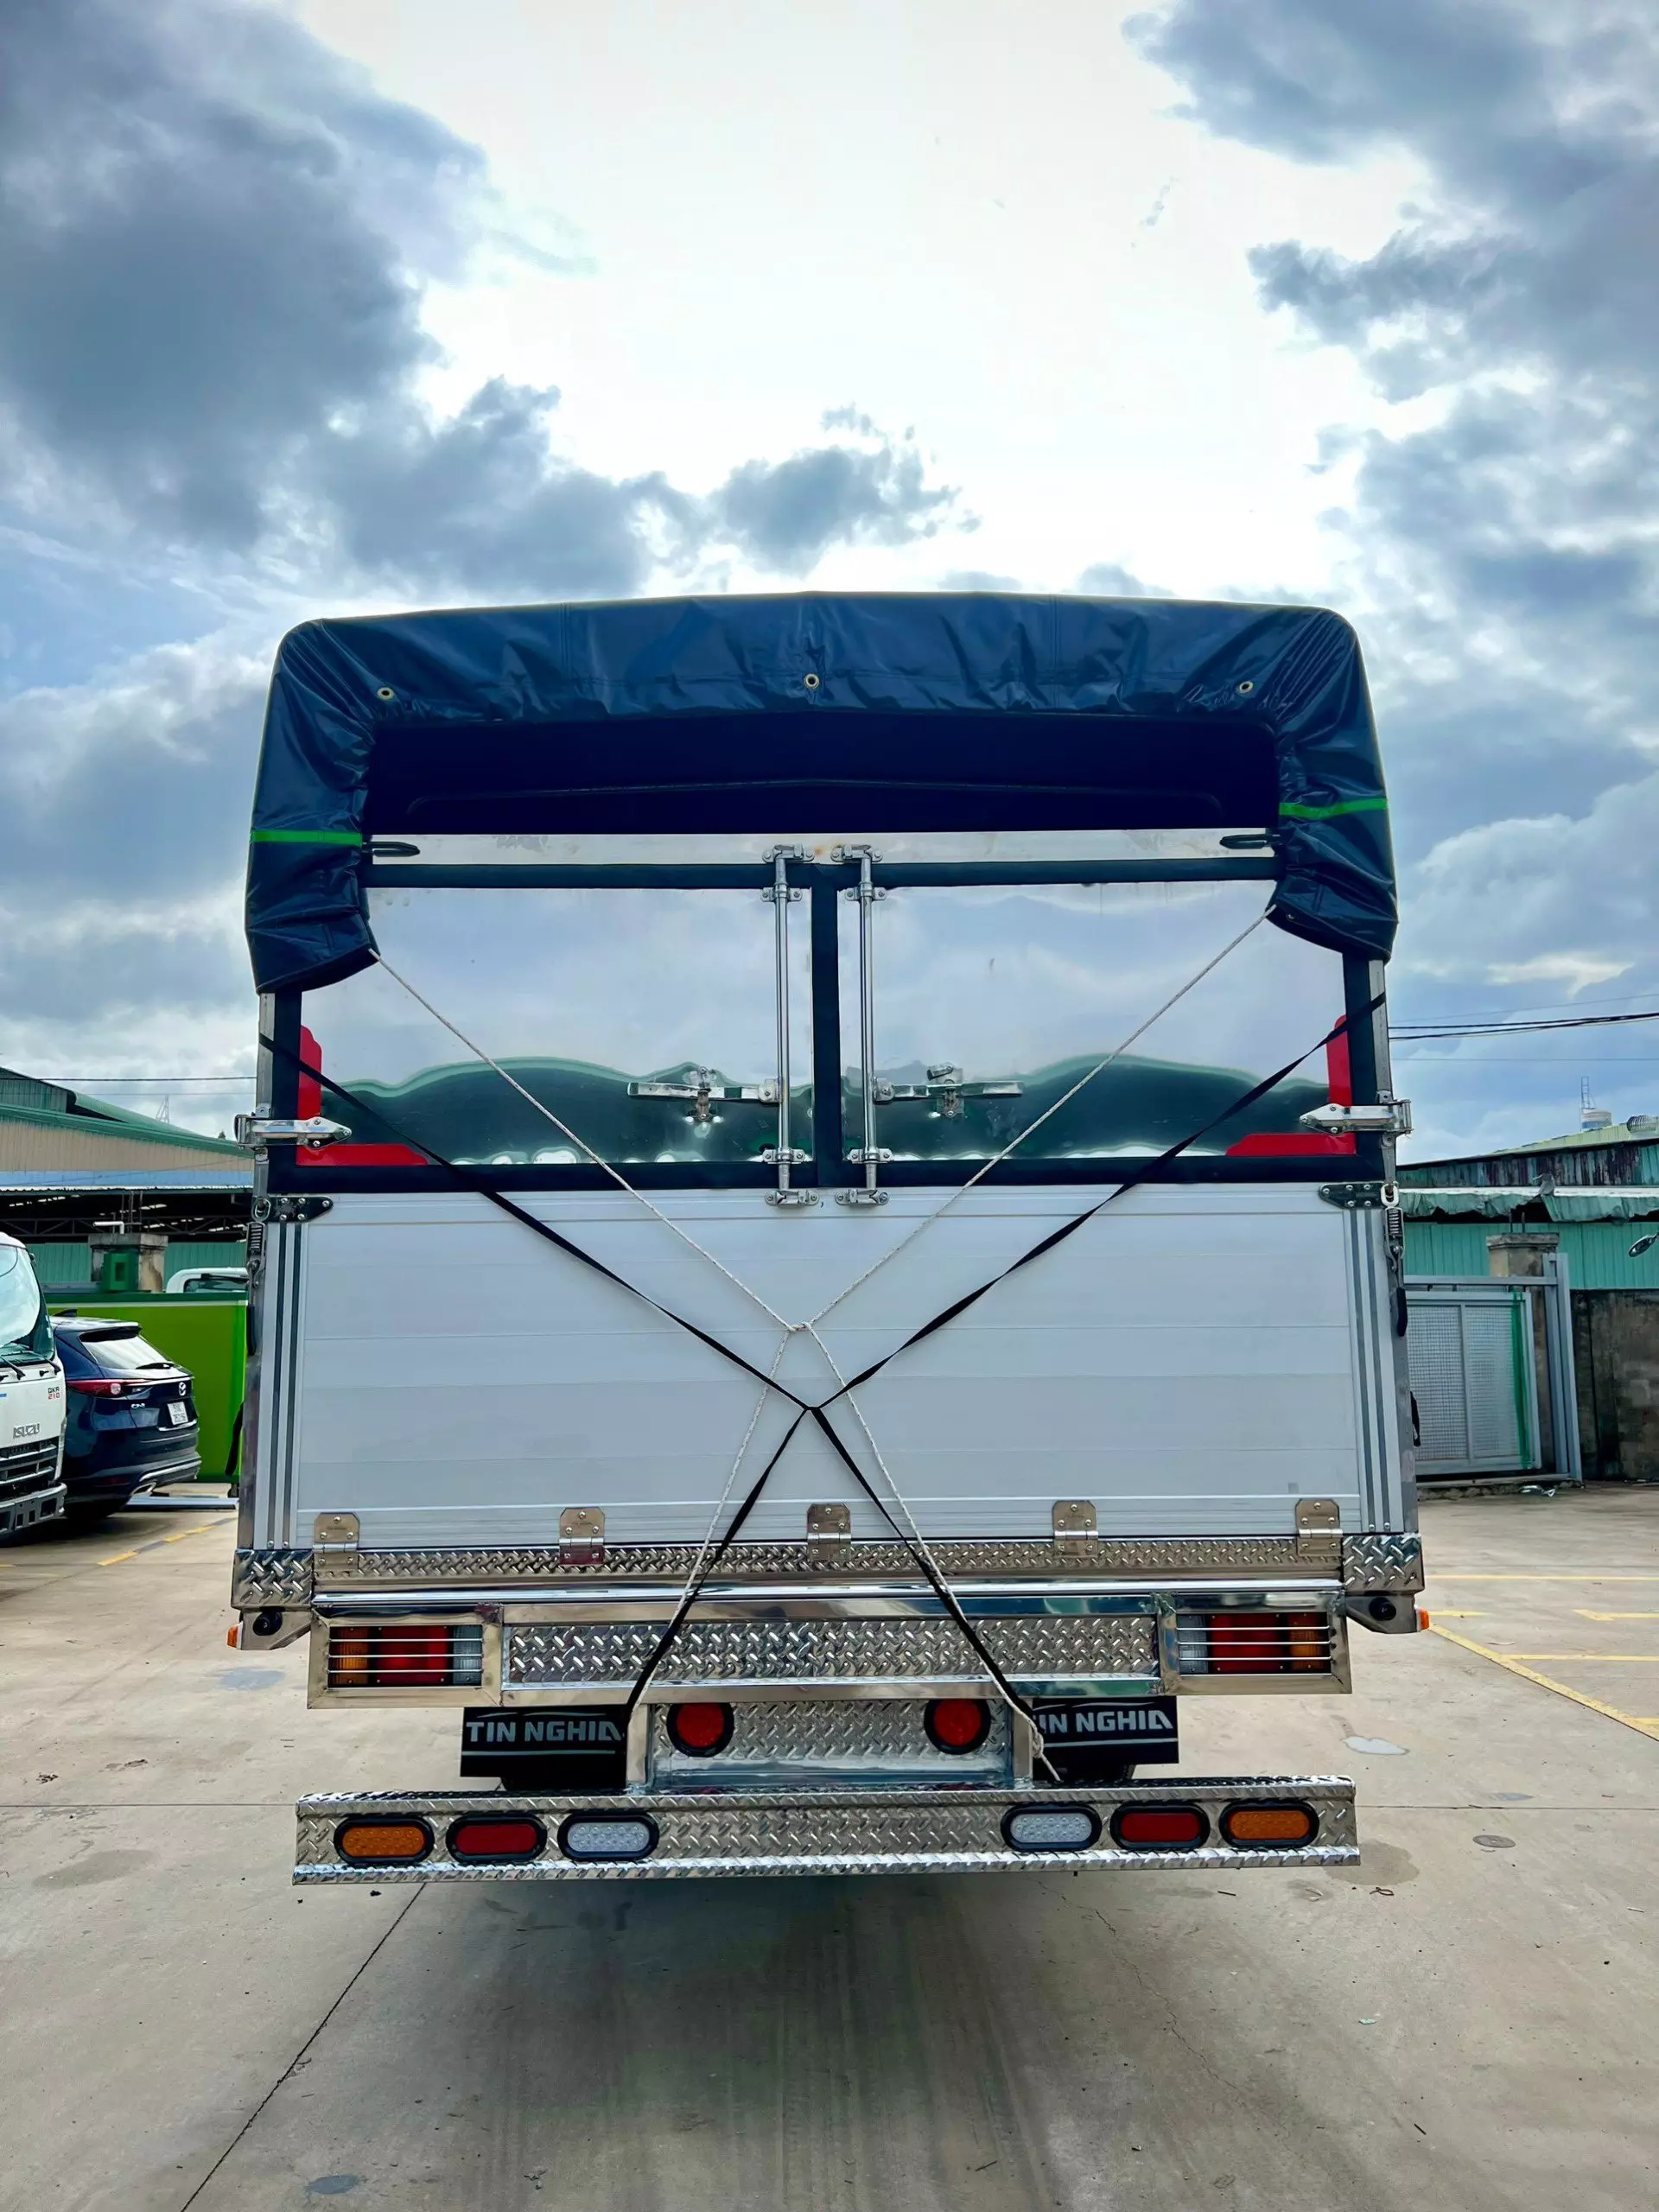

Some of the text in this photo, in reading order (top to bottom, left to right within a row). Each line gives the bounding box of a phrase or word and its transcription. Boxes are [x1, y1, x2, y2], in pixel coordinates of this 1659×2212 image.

[13, 1423, 40, 1439] ISUZU
[466, 1720, 622, 1742] TIN NGHIA
[1033, 1710, 1173, 1733] IN NGHIA
